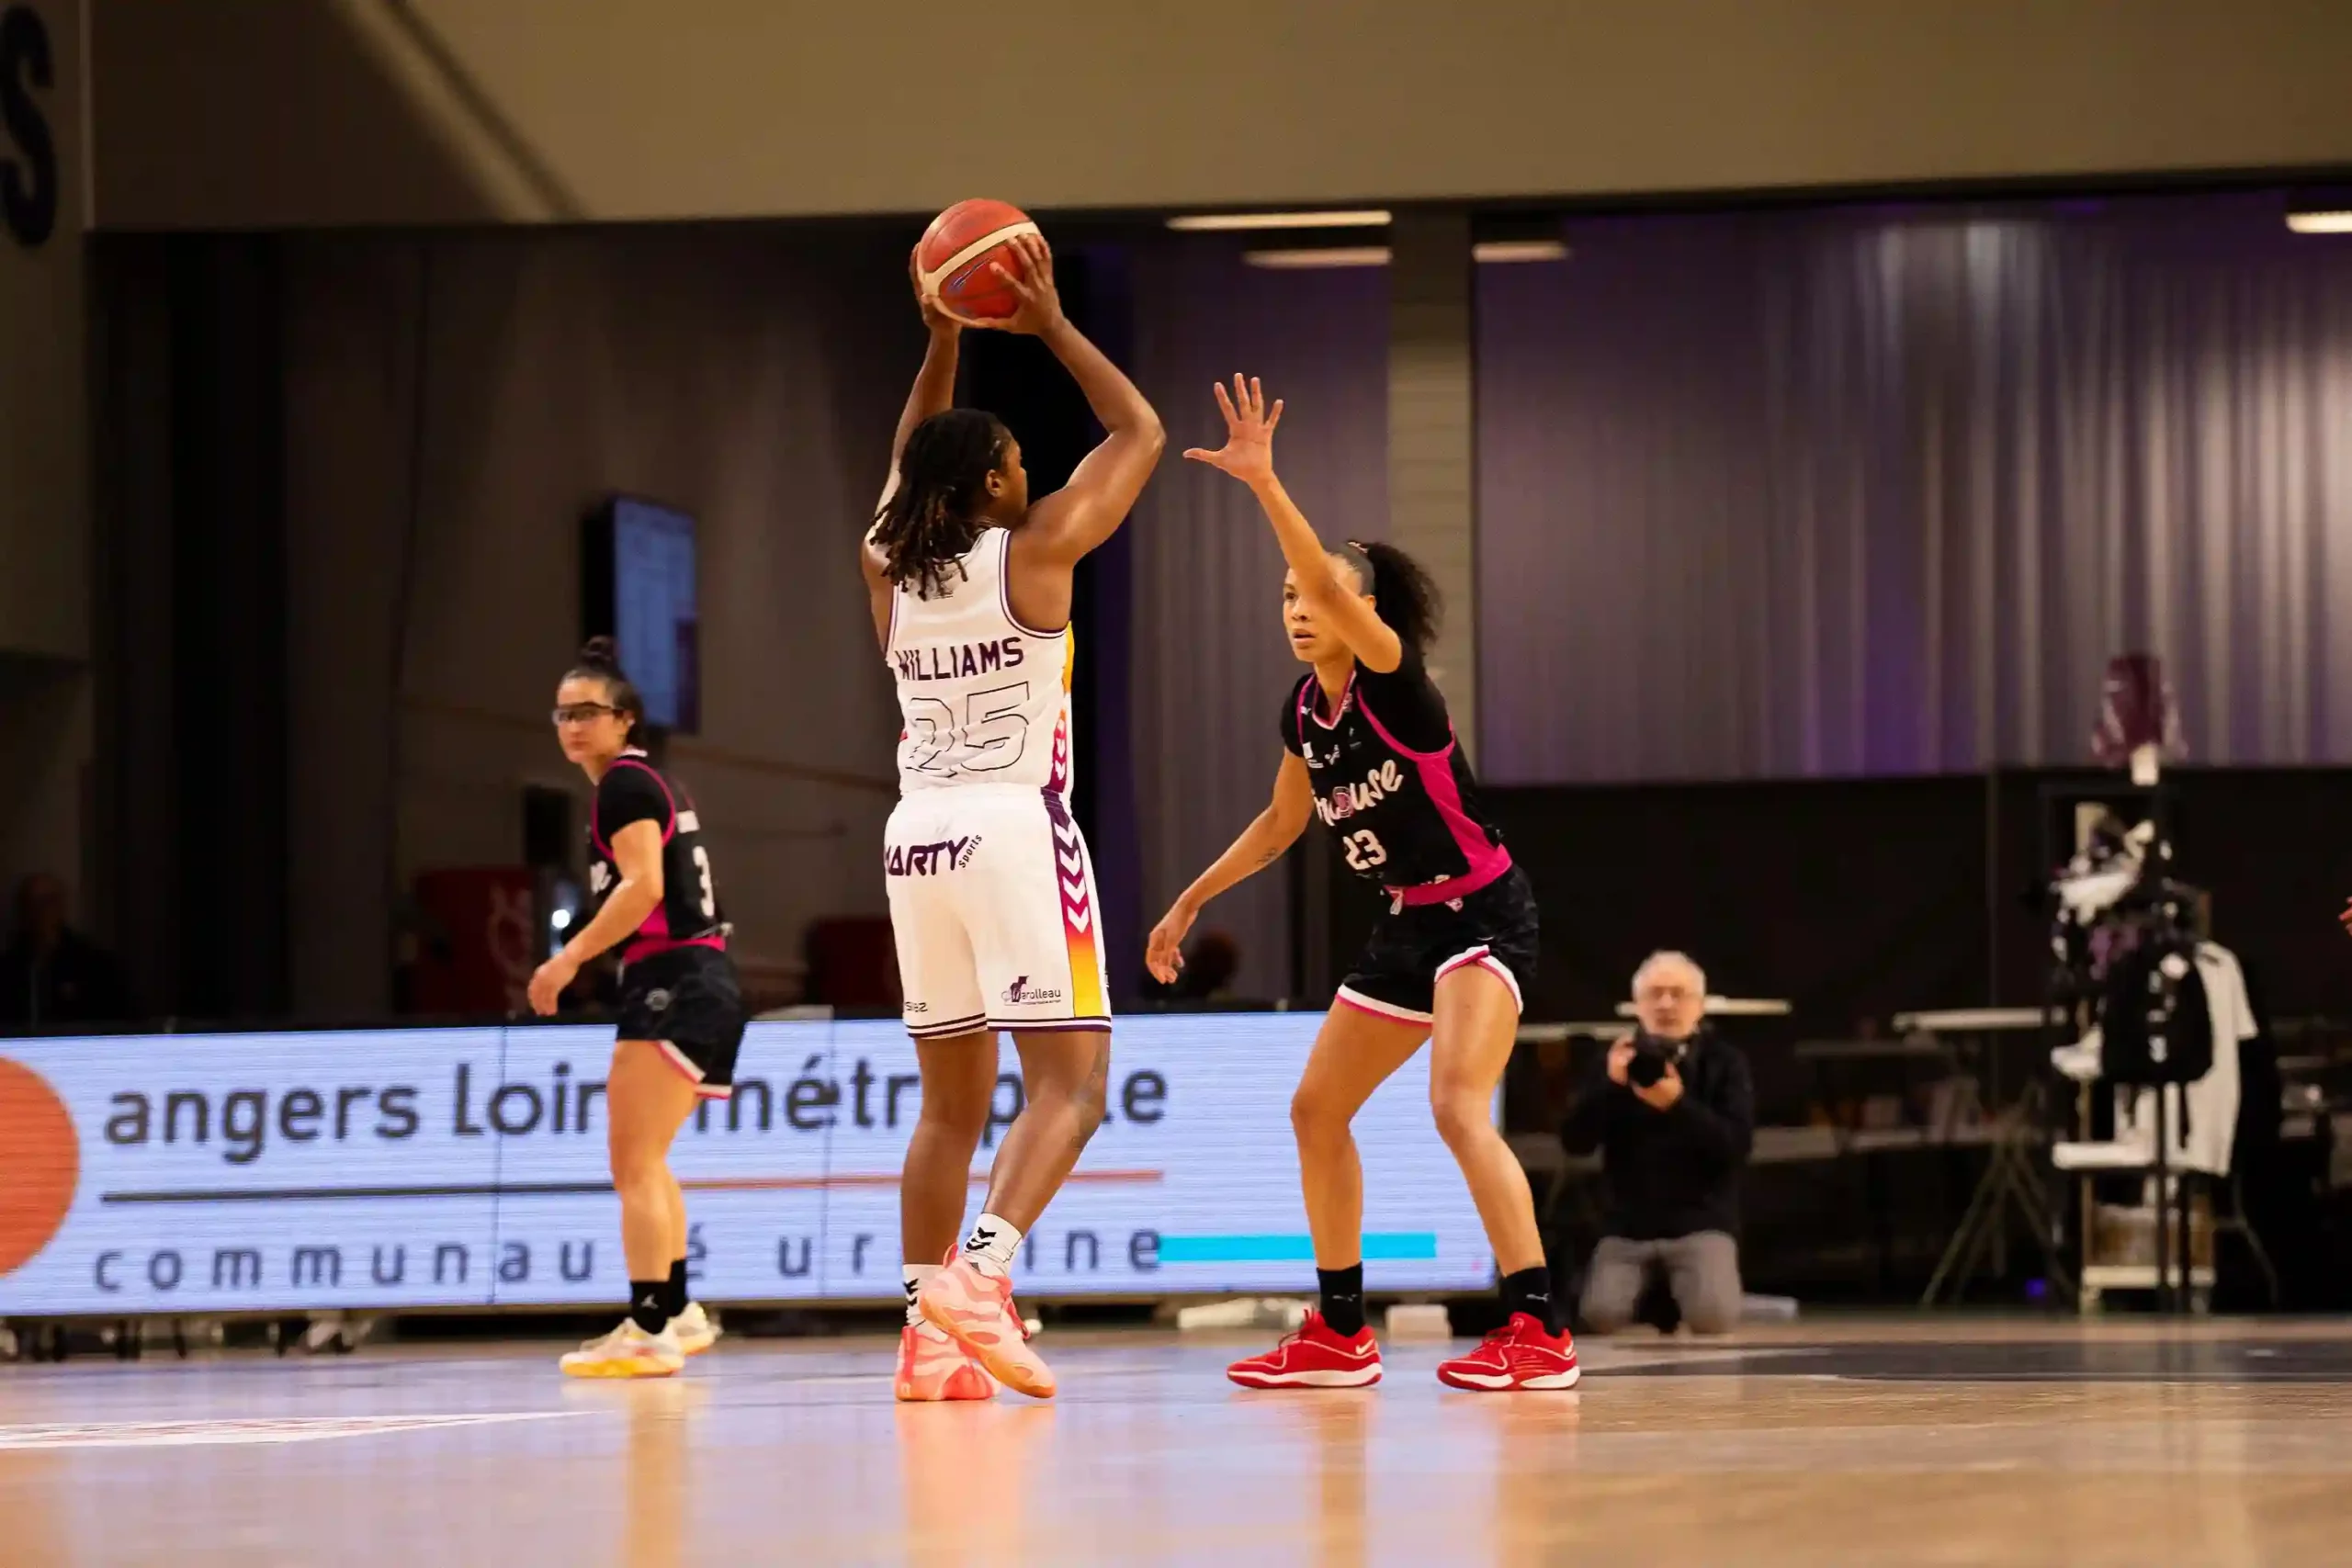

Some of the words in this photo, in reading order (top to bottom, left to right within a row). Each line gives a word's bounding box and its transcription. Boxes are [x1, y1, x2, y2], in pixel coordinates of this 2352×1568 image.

[894, 637, 1024, 682] WILLIAMS
[904, 681, 1031, 779] 25
[886, 836, 969, 876] ARTY
[1342, 829, 1387, 871] 23
[103, 1085, 420, 1166] angers
[453, 1061, 608, 1137] Loir
[695, 1054, 1169, 1149] métrpe
[95, 1221, 707, 1292] communaué
[777, 1227, 1163, 1278] urine
